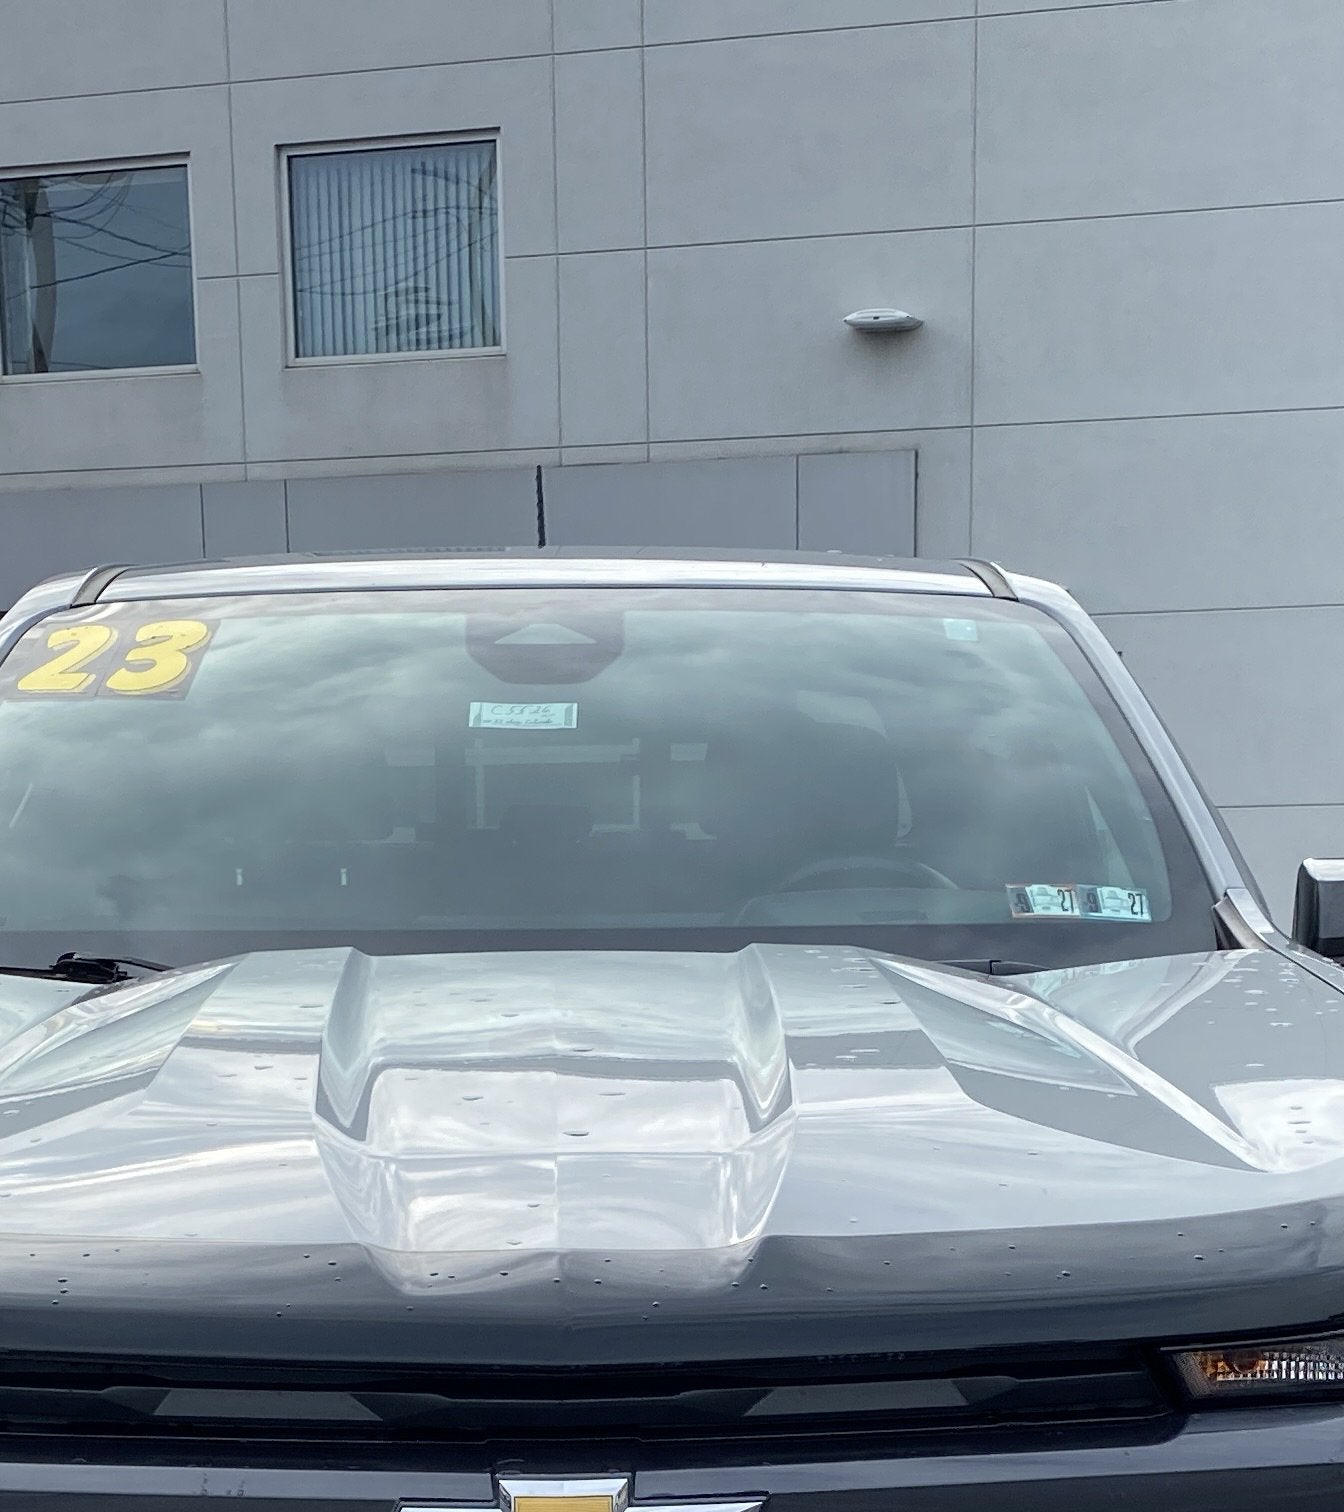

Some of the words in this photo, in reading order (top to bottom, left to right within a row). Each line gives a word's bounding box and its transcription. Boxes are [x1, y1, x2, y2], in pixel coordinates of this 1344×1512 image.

[17, 620, 212, 695] 23
[1056, 888, 1074, 914] 27
[1127, 892, 1144, 917] 27
